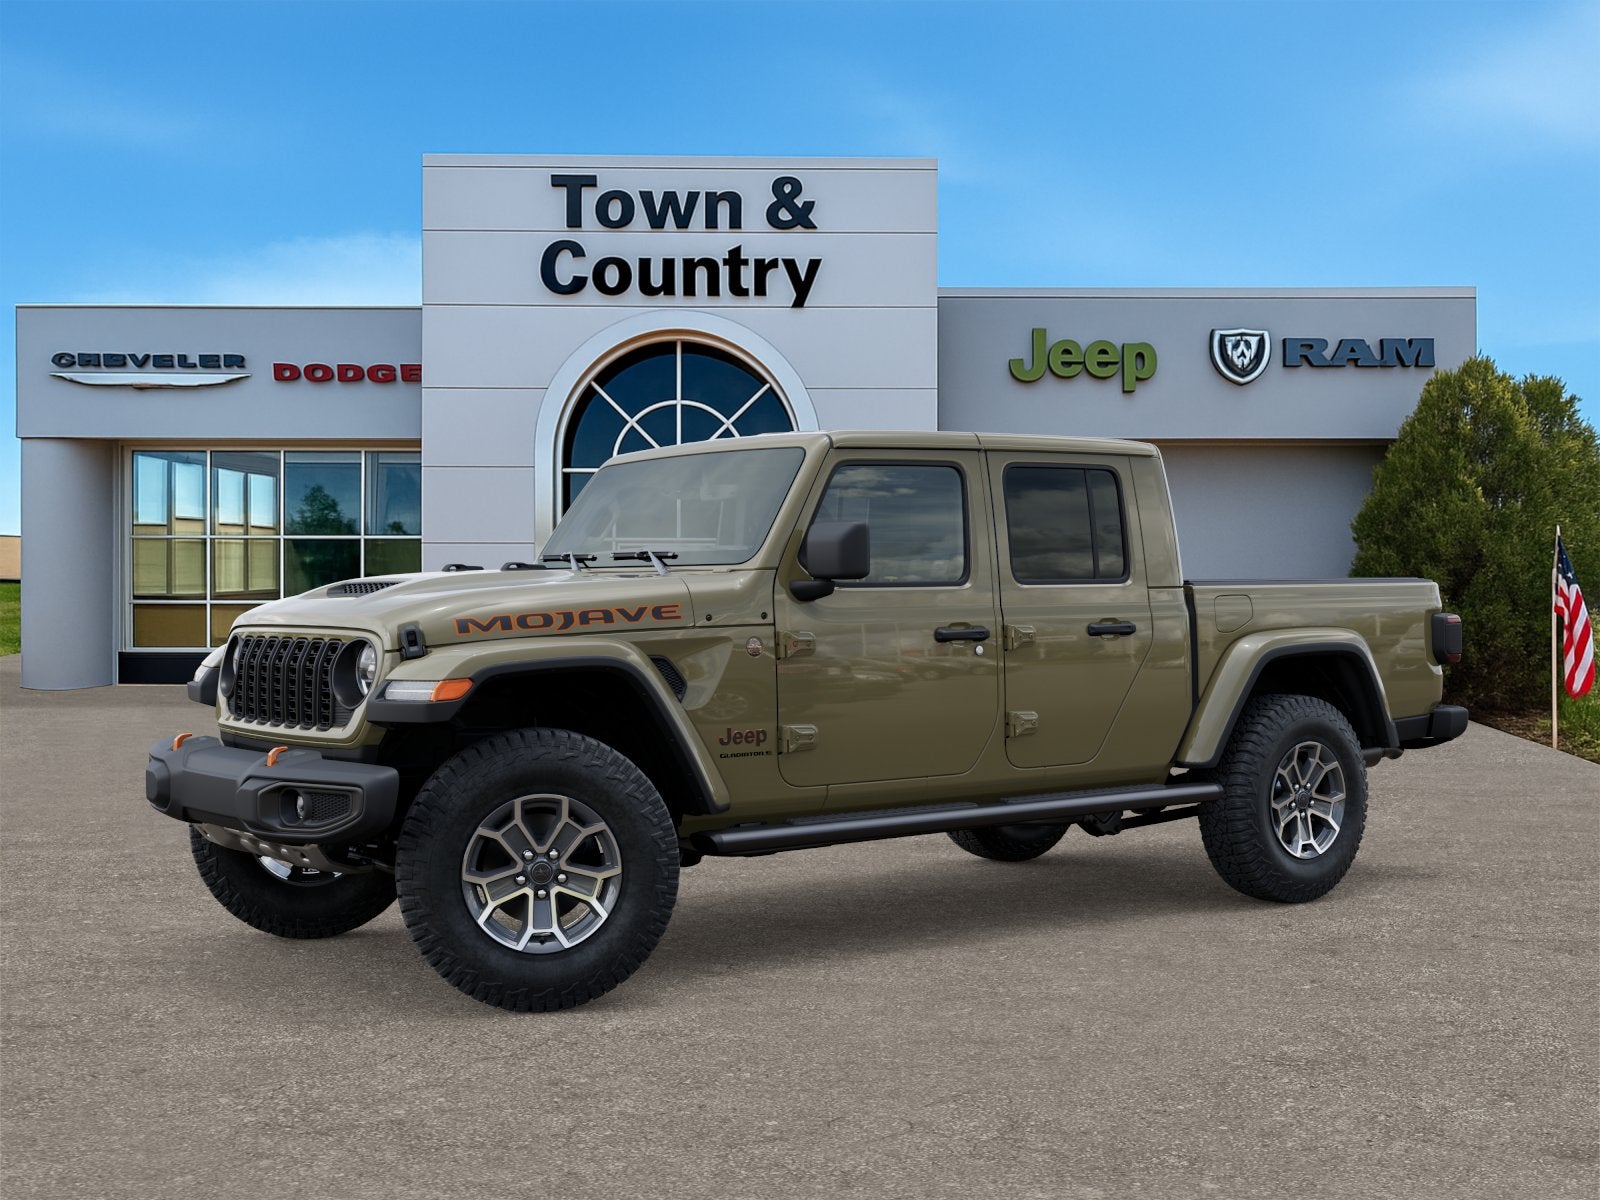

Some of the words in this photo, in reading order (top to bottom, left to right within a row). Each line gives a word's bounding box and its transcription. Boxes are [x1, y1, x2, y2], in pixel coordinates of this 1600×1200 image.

[551, 174, 742, 229] Town
[765, 176, 817, 229] &
[540, 239, 822, 308] Country
[1009, 328, 1157, 392] Jeep
[1283, 338, 1435, 367] RAM
[273, 363, 422, 383] DODGE
[455, 604, 682, 637] MOJAVE
[719, 727, 767, 746] Jeep
